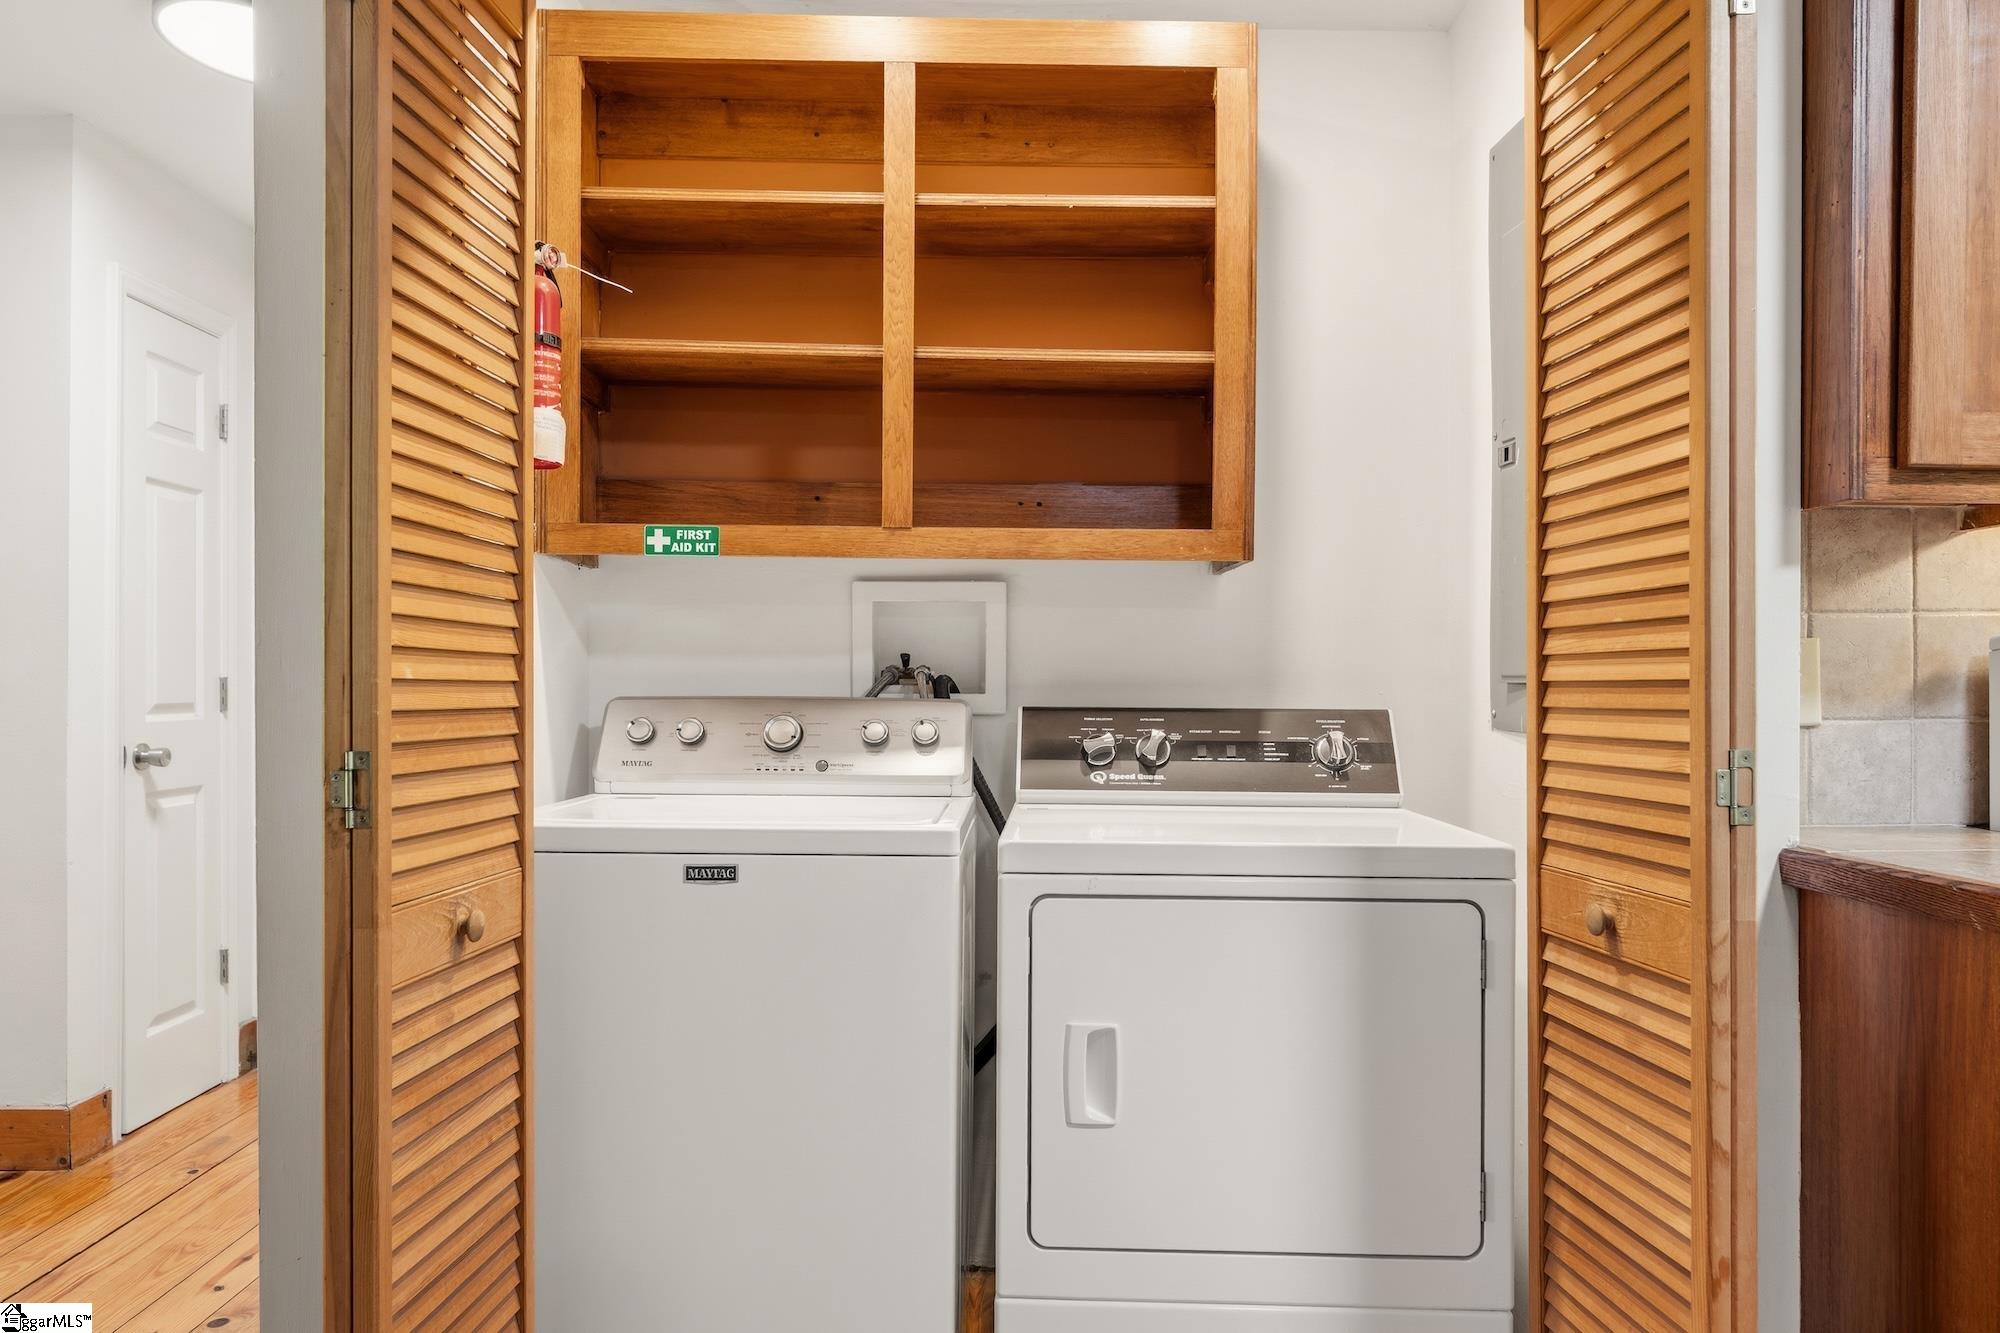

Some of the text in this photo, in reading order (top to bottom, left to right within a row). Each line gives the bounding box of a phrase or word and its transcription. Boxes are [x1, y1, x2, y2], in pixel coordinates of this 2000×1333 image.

[676, 529, 712, 540] FIRST
[670, 542, 717, 553] AID KIT
[1108, 773, 1136, 781] Speed
[687, 868, 735, 879] MAYTAG
